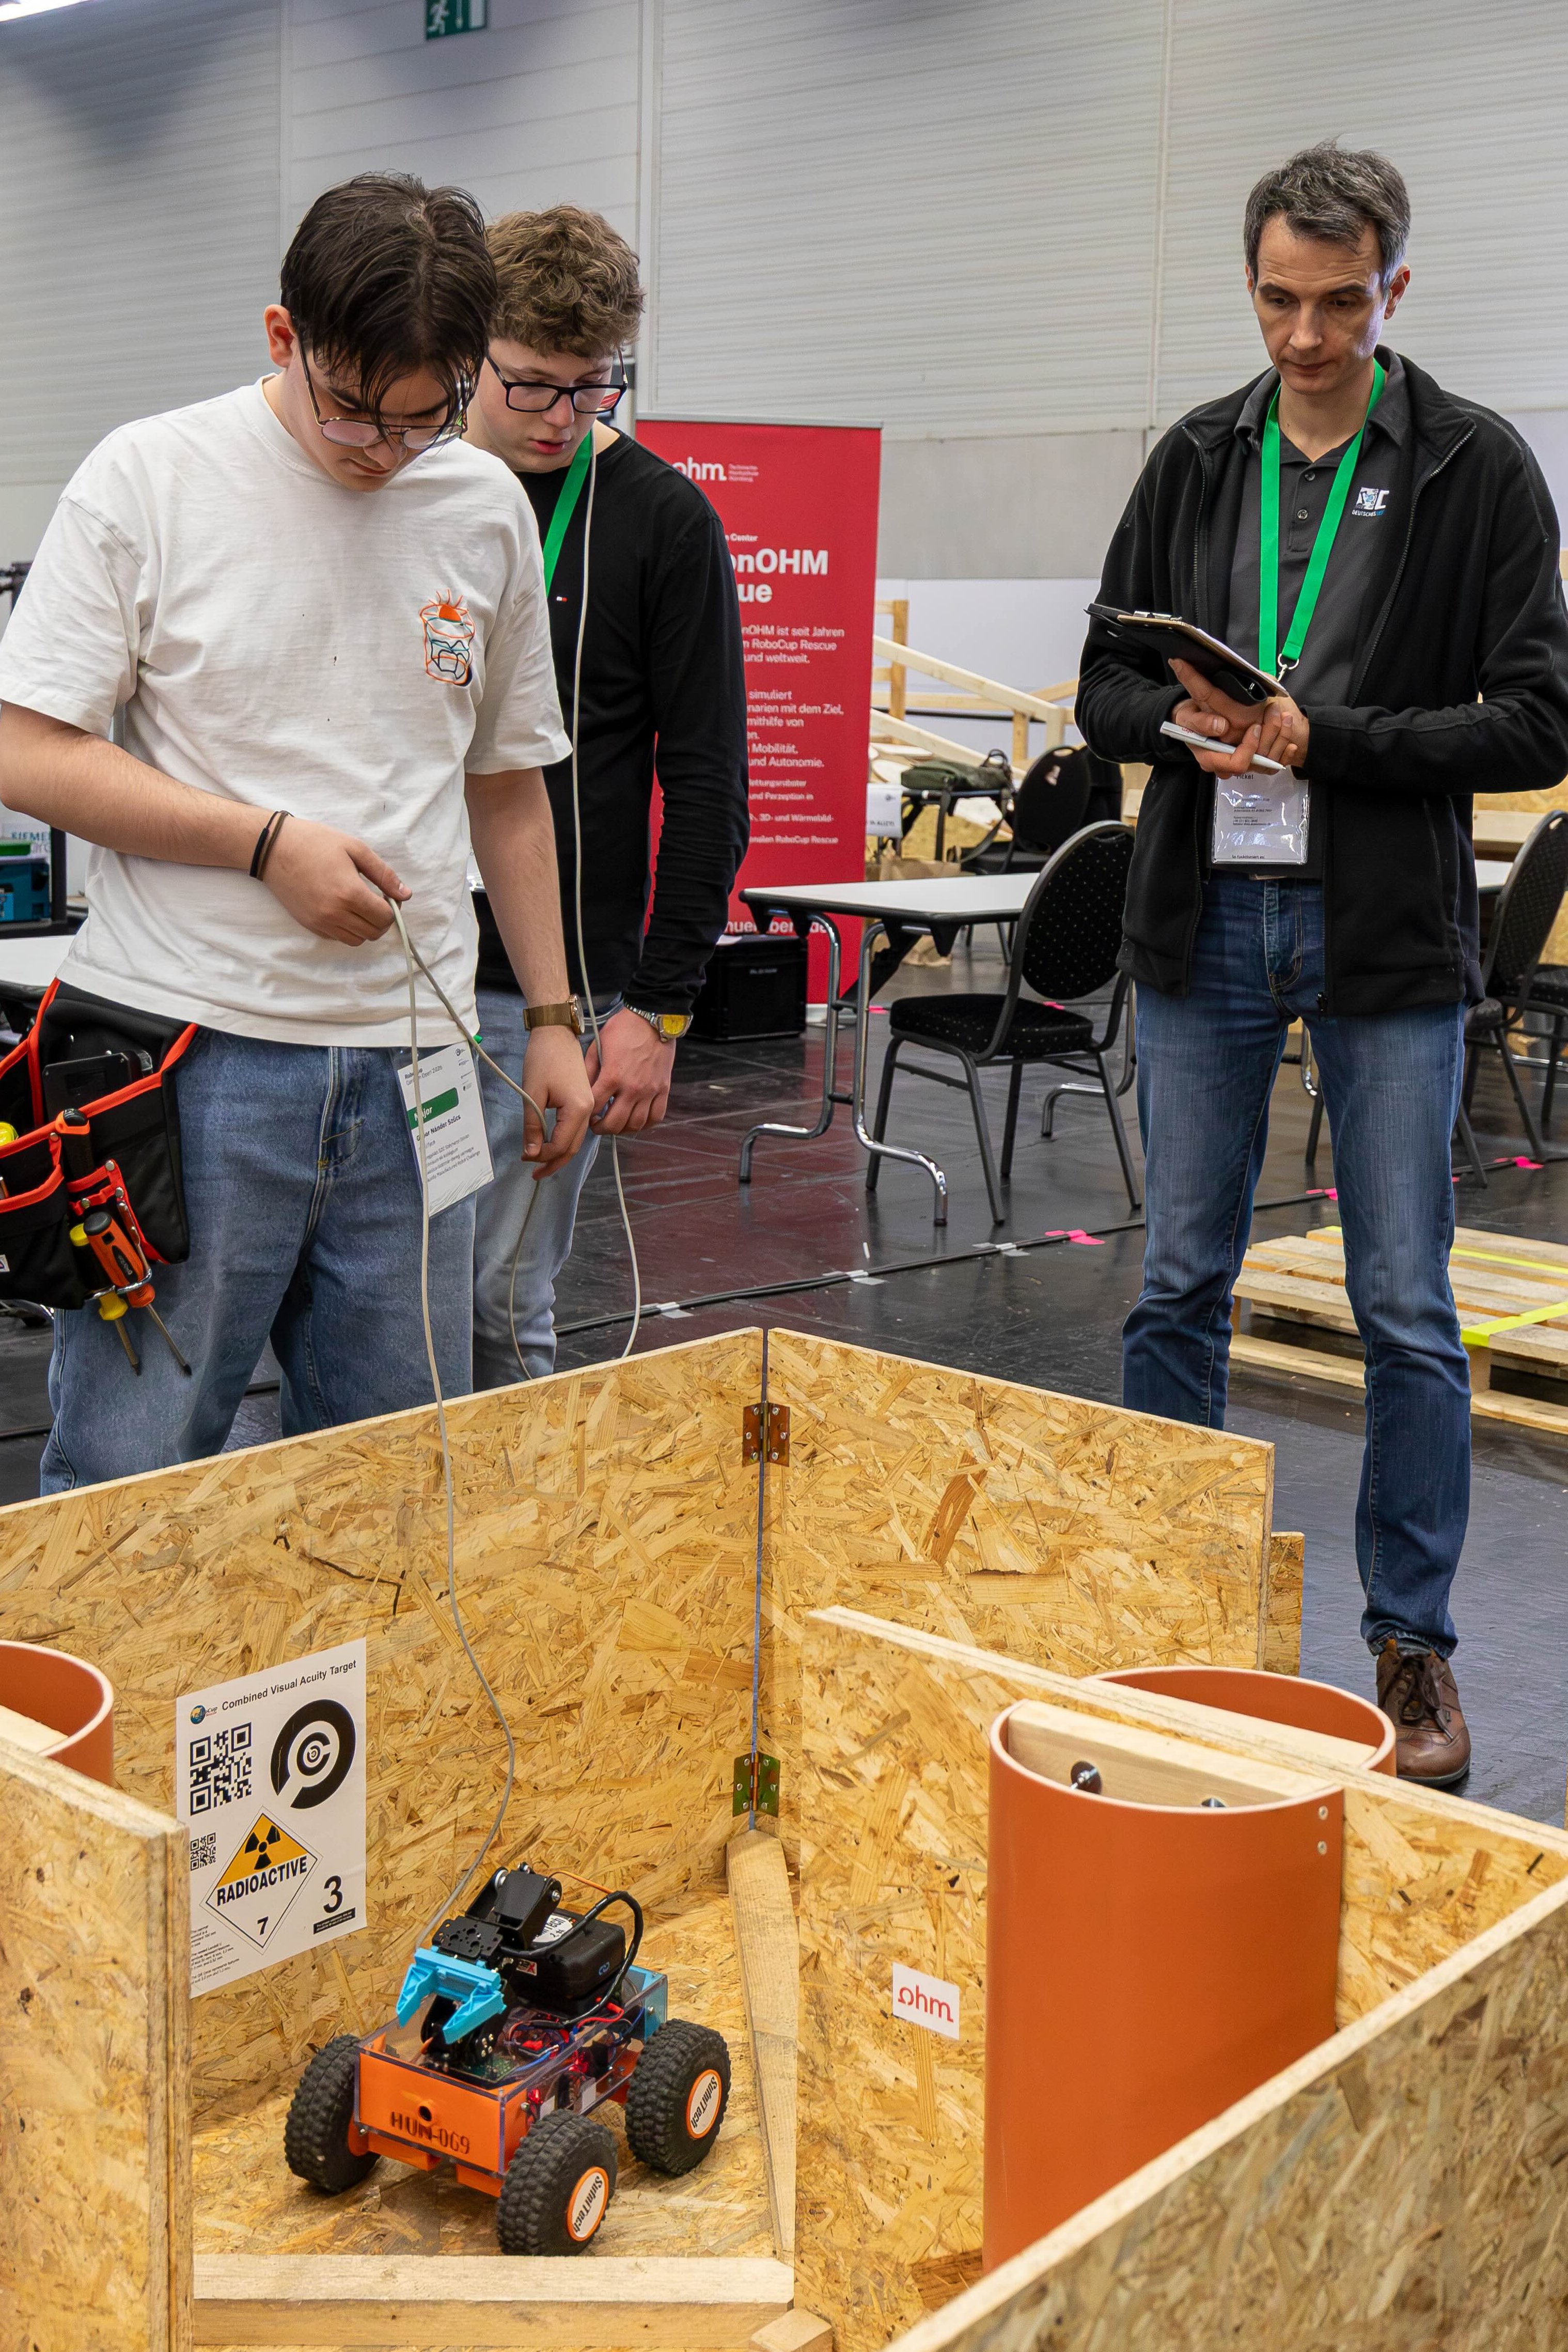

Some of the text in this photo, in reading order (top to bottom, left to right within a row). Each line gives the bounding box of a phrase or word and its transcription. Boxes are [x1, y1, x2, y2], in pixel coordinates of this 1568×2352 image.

[730, 533, 758, 542] Center
[777, 626, 789, 636] ist
[791, 626, 809, 637] seit
[812, 626, 844, 637] Jahren
[751, 638, 798, 651] RoboCup
[801, 639, 837, 651] Rescue
[749, 689, 792, 700] simuliert
[781, 704, 796, 714] mit
[799, 703, 821, 714] dem
[786, 718, 804, 727] von
[414, 1106, 433, 1121] Mjor
[222, 1688, 268, 1711] Combined
[271, 1678, 297, 1695] Visual
[300, 1670, 327, 1686] Acuity
[330, 1659, 356, 1675] Target
[217, 1855, 307, 1907] RADIOACTIVE
[323, 1875, 343, 1914] 3
[257, 1916, 269, 1936] 7
